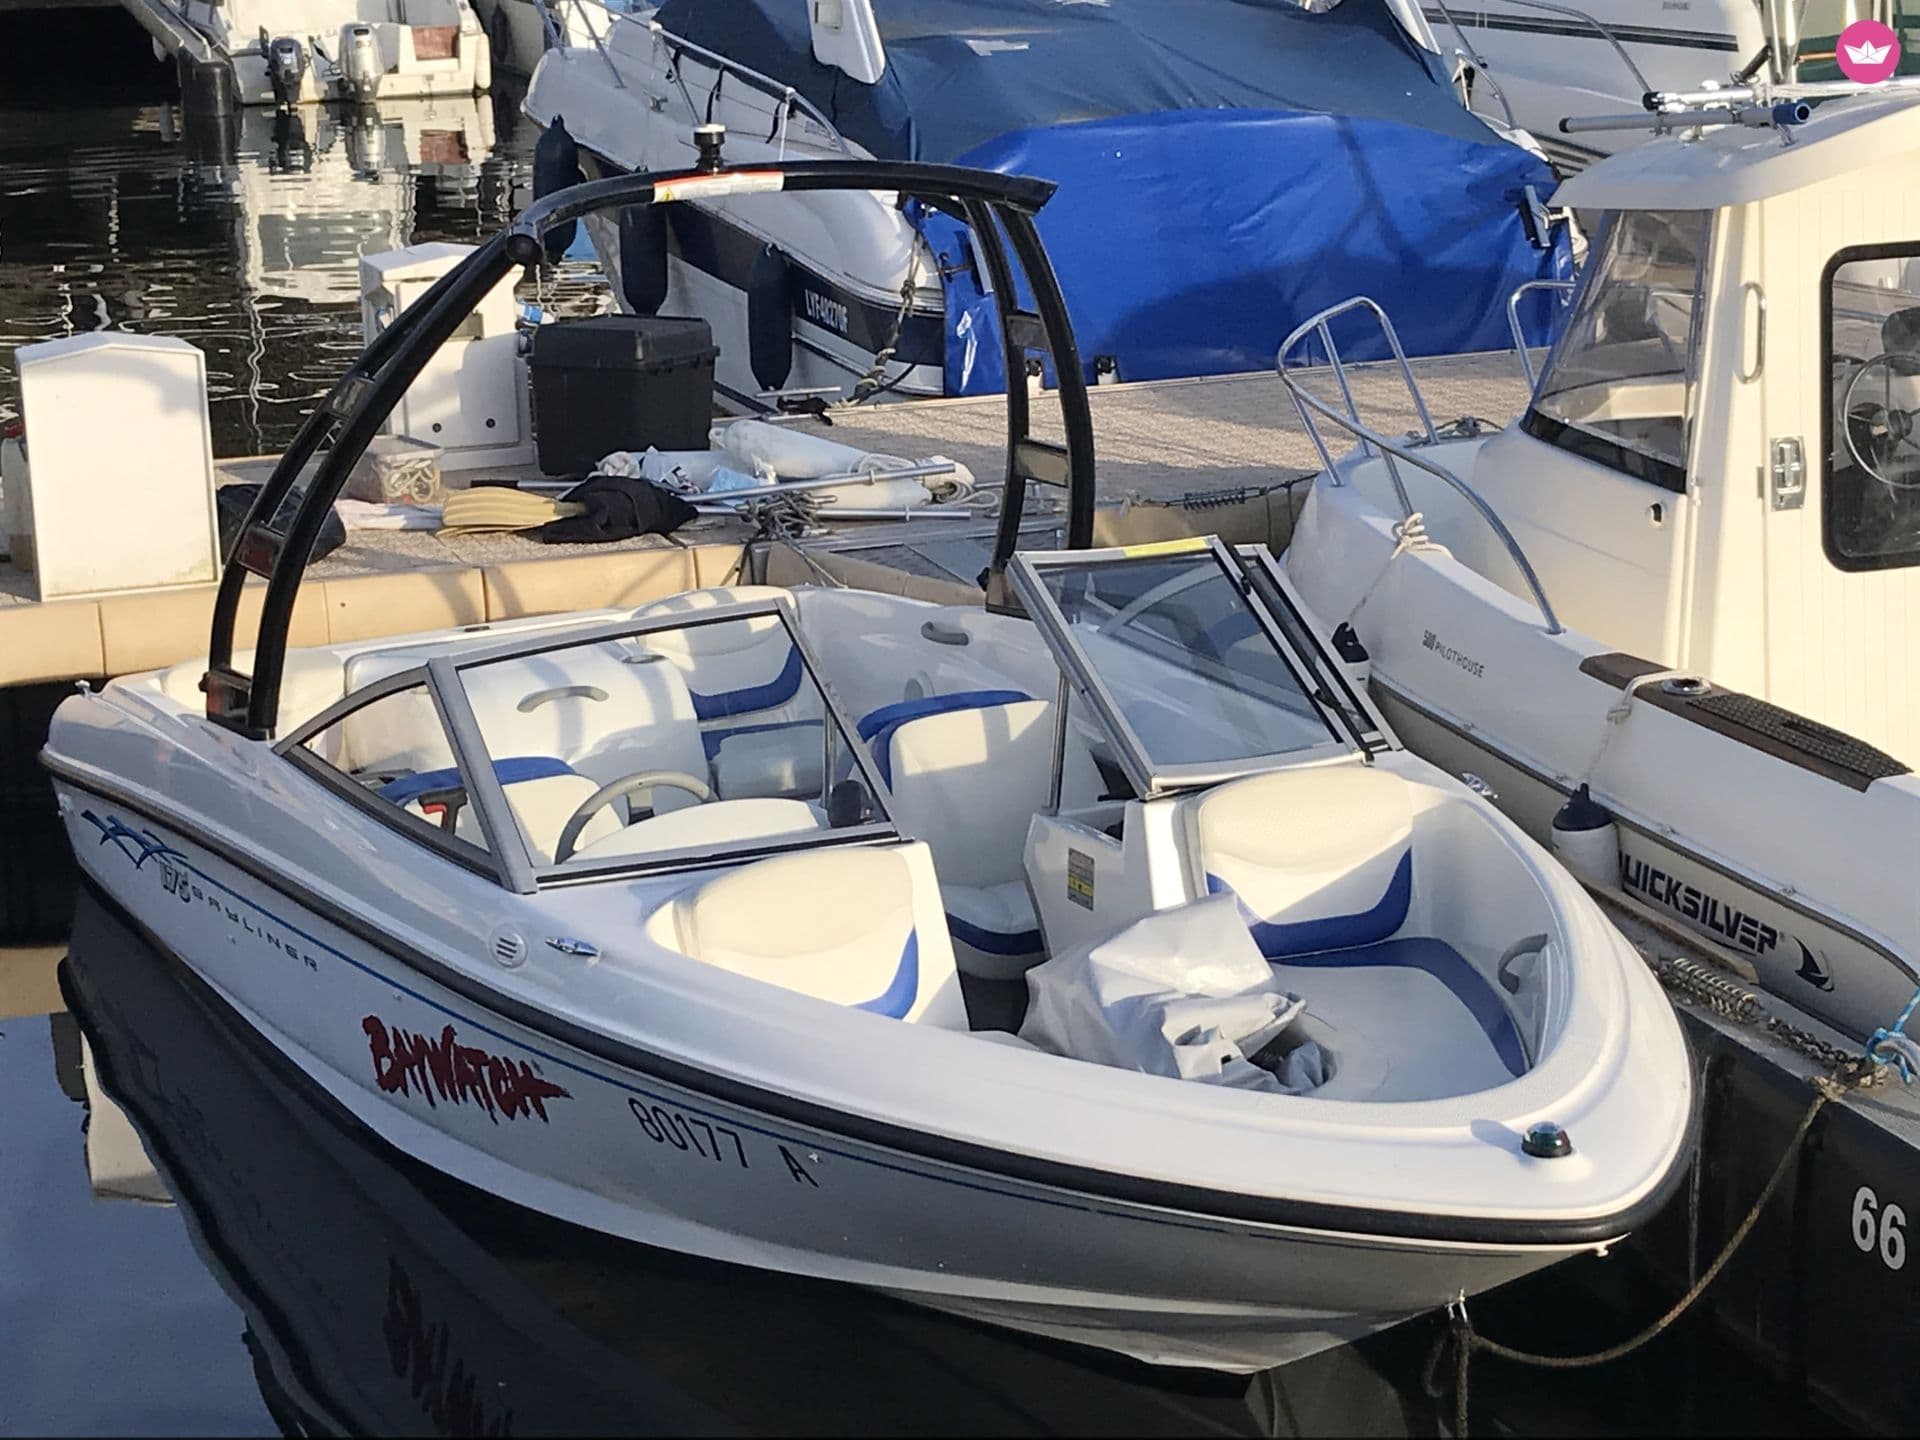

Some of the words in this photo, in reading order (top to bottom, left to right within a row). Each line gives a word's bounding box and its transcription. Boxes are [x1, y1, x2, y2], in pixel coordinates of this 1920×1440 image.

[1434, 640, 1485, 678] PILOTHOUSE
[191, 884, 318, 972] BAYLINER
[1618, 850, 1778, 954] UICKSILVER
[361, 1014, 574, 1125] BAYWATCH
[627, 1096, 749, 1169] 80177
[777, 1143, 819, 1188] A
[1852, 1186, 1907, 1270] 66
